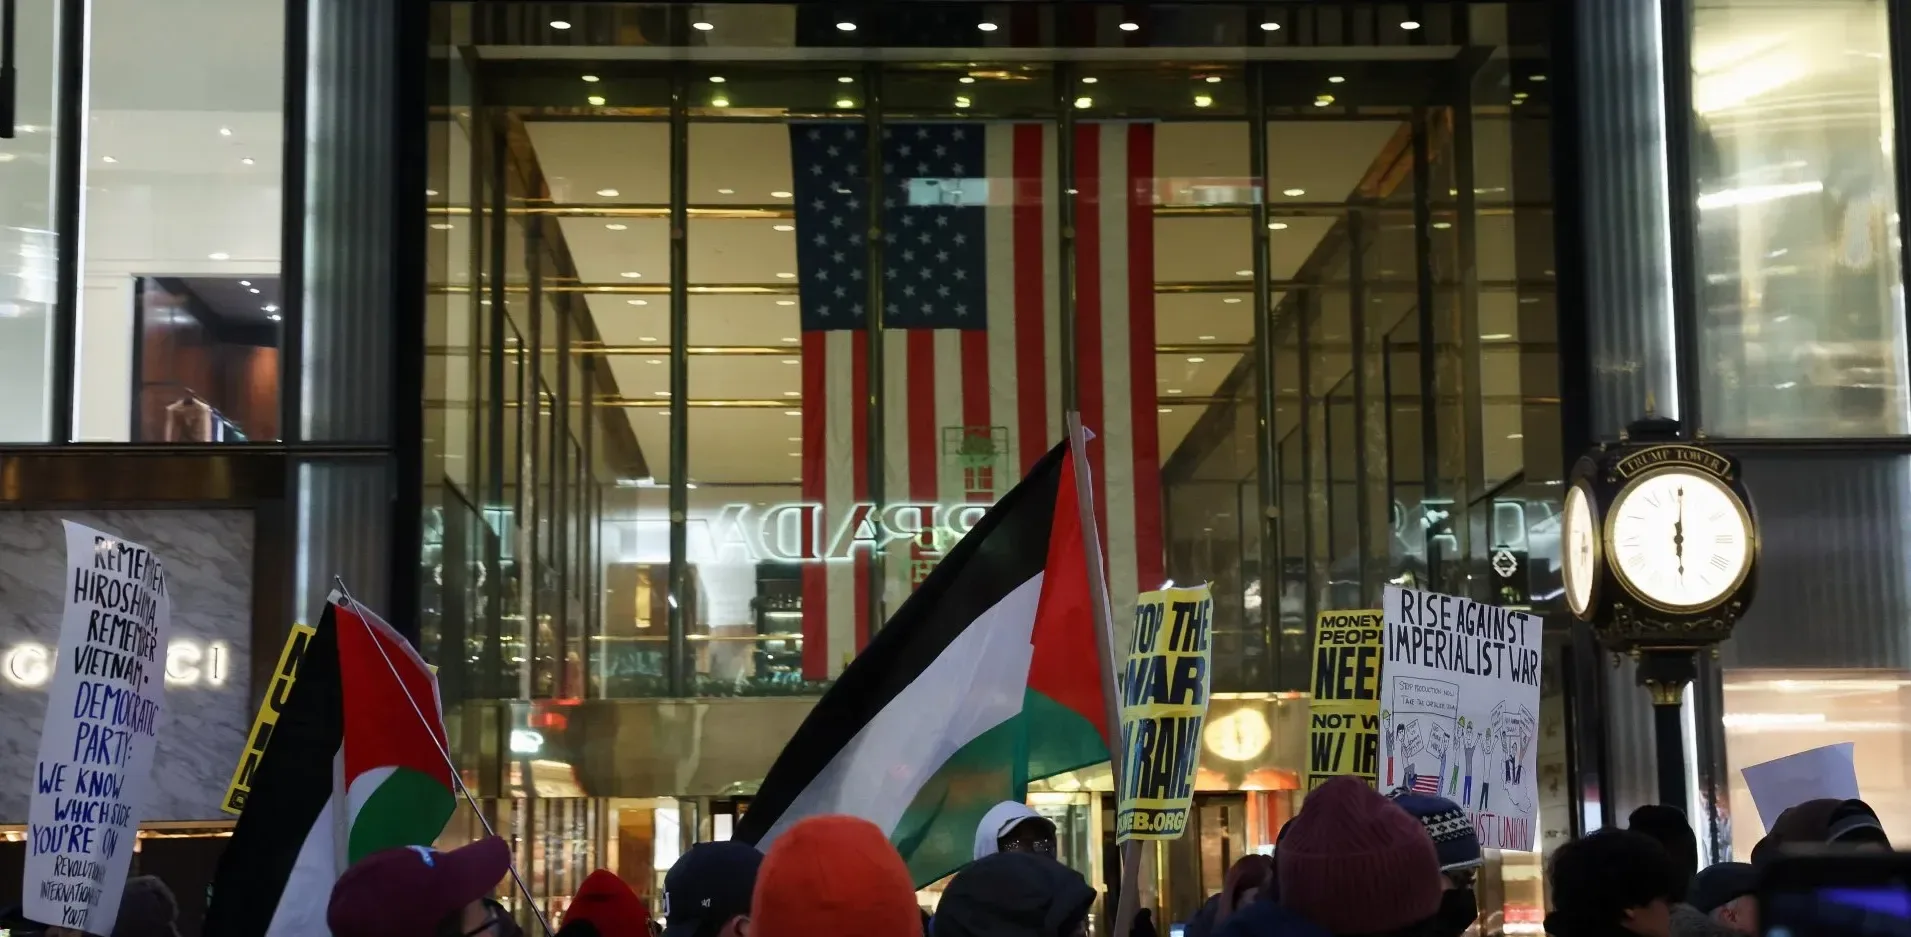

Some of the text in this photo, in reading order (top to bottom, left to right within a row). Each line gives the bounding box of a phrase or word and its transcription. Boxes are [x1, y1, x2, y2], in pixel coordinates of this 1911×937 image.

[1627, 449, 1720, 470] TRUMP TOWER
[74, 567, 158, 636] HIROSHIMA,
[1320, 615, 1383, 628] MONEY
[1402, 589, 1529, 646] RISE AGAINST
[87, 609, 157, 662] REMEMBER
[1129, 598, 1210, 656] TOP THE
[8, 643, 221, 685] GCI
[75, 644, 149, 693] VIETNAM.
[1315, 646, 1384, 700] NEE
[1388, 622, 1538, 687] IMPERIALIST WAR
[1124, 655, 1206, 708] WAR
[74, 681, 159, 737] DEMOCRATIC
[1311, 714, 1356, 729] NOT
[73, 721, 133, 768] PARTY:
[1130, 716, 1202, 800] IRAN!
[1311, 732, 1346, 772] W/
[1352, 732, 1379, 773] IR
[39, 761, 125, 800] WE KNOW
[55, 797, 131, 828] WHICH SIDE
[1497, 815, 1528, 850] UNION
[32, 823, 118, 860] YOU'RE ON
